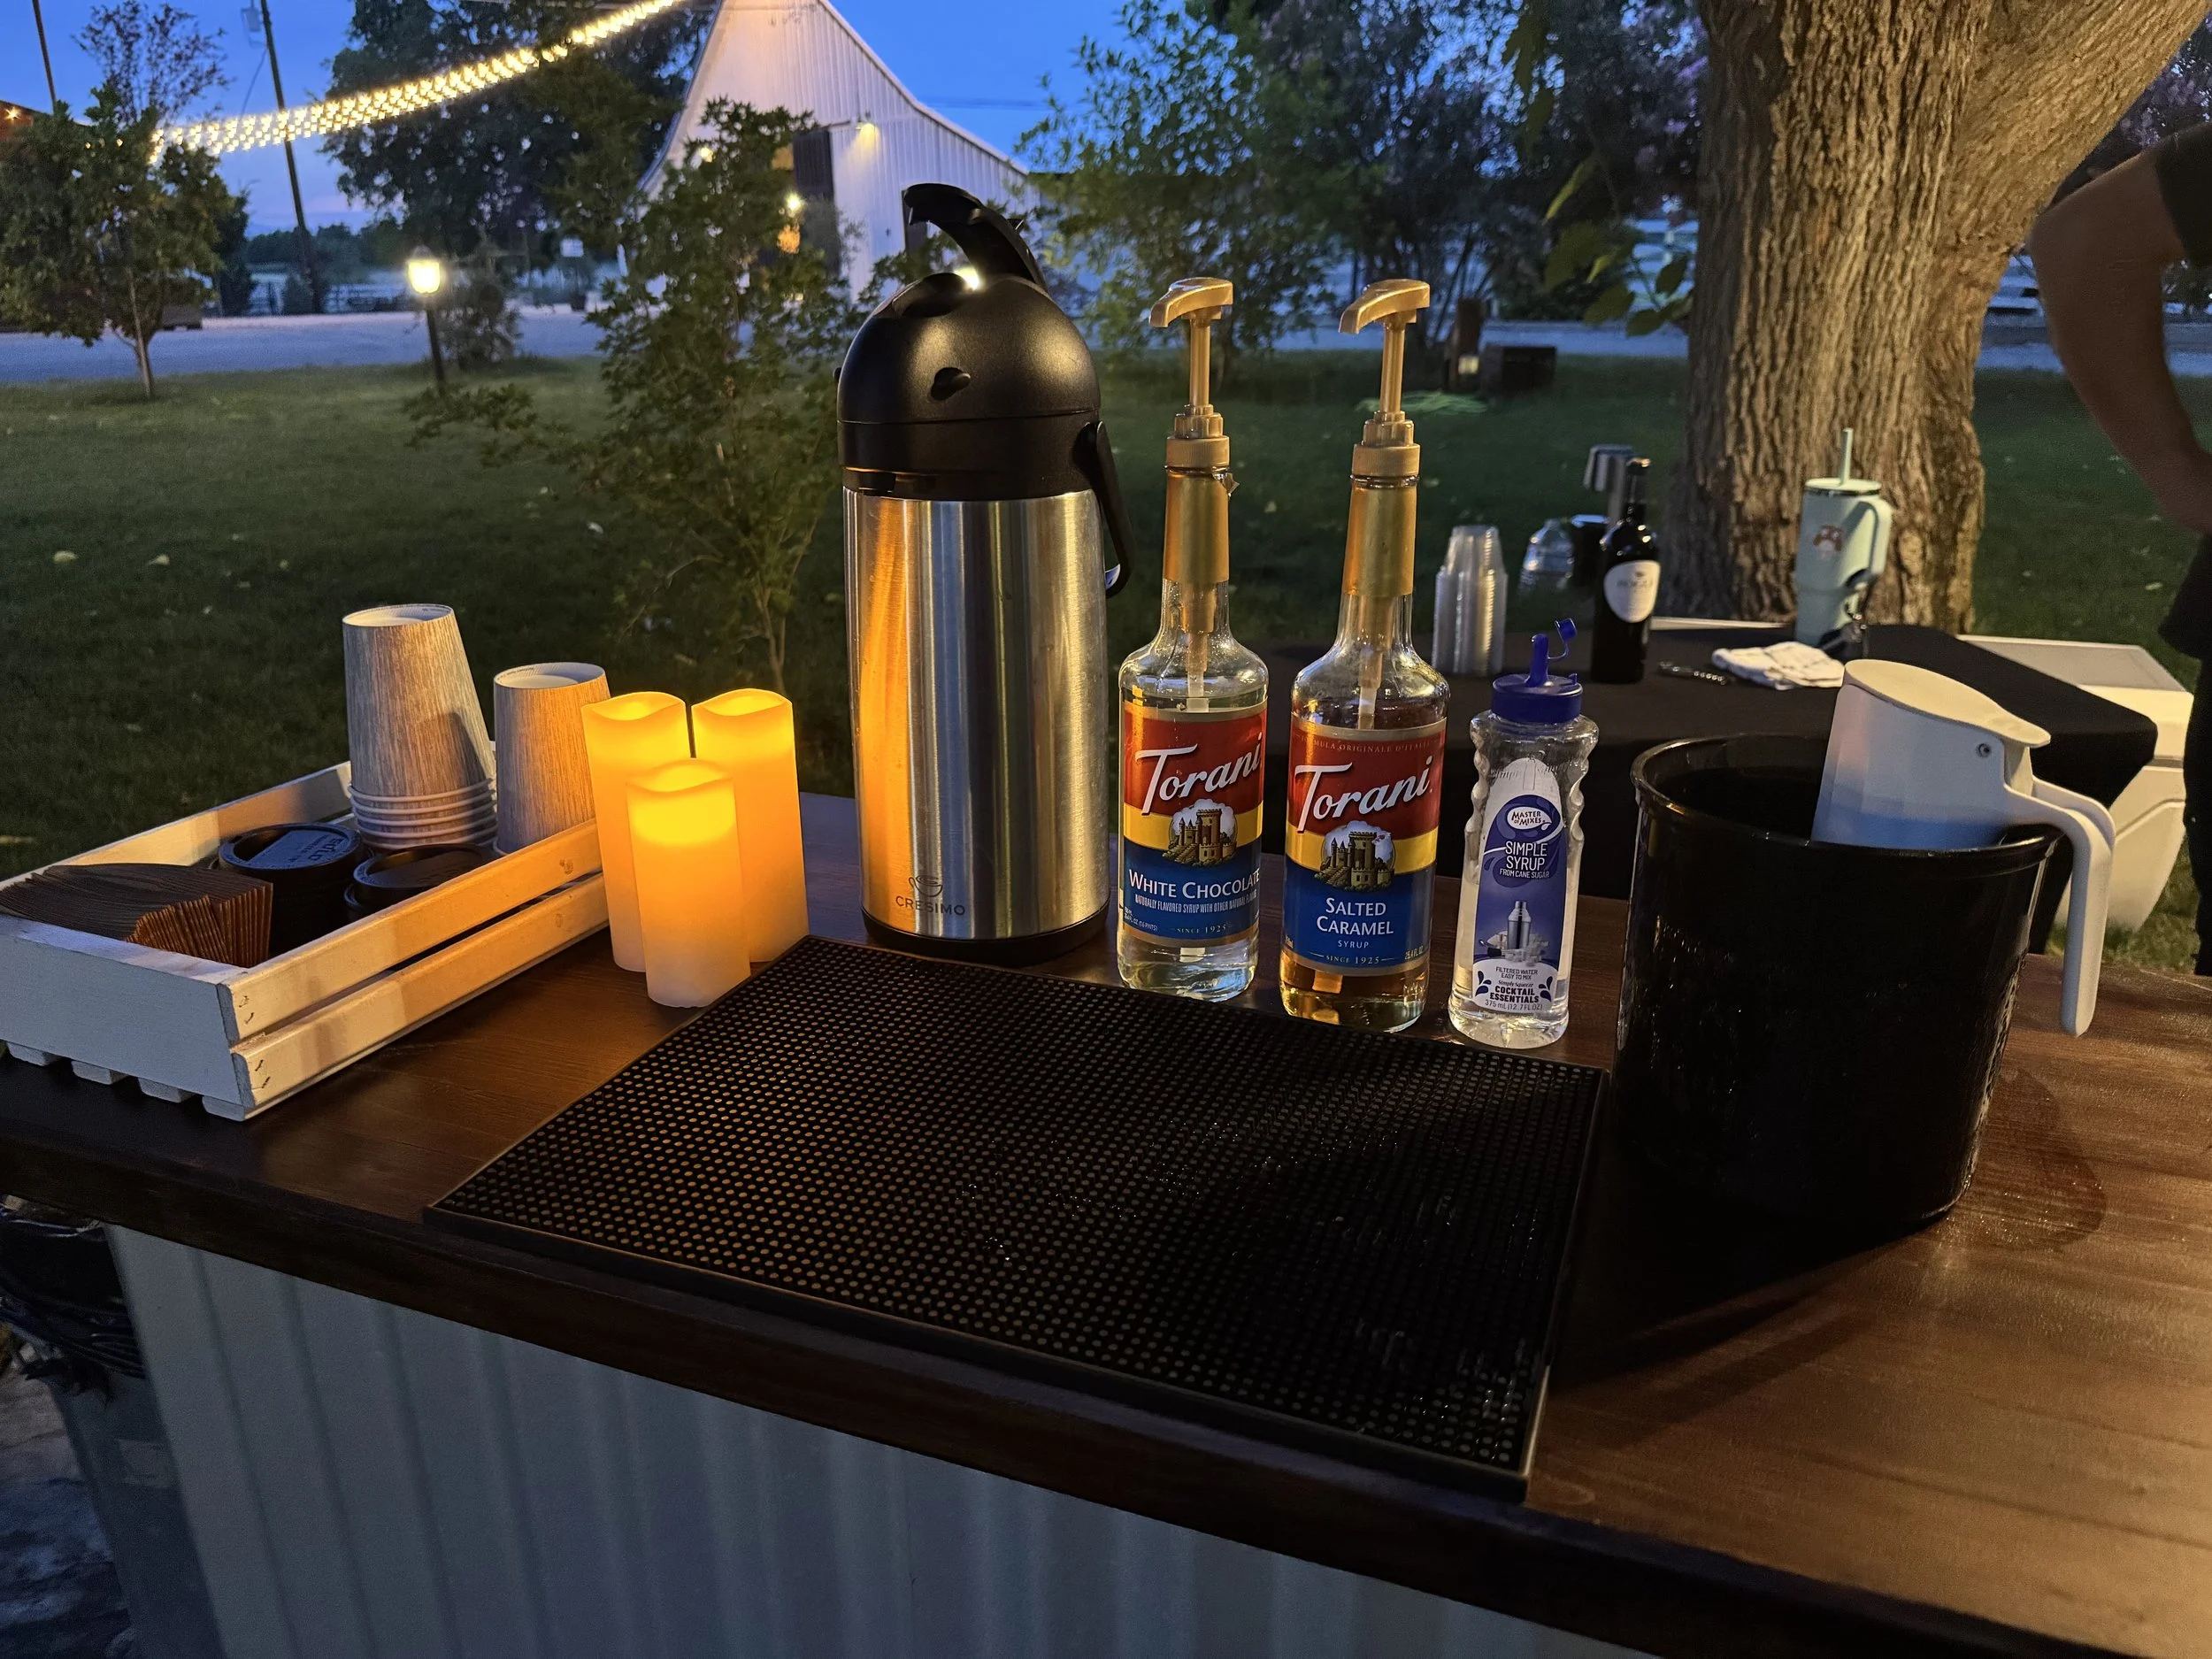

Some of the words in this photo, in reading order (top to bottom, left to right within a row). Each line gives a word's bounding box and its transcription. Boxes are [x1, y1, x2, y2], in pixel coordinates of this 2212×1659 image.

[1301, 736, 1336, 750] FOMULA
[1338, 743, 1392, 754] ORIGINALE
[1135, 731, 1263, 816] Torani
[1294, 755, 1433, 833] Torani
[1511, 810, 1541, 821] MASTER
[1519, 817, 1541, 826] MIXES
[1505, 841, 1548, 856] SIMPLE
[1506, 856, 1545, 871] SYRUP
[1499, 868, 1515, 878] FROM
[1128, 868, 1177, 898] WHITE
[1182, 867, 1260, 899] CHOCOLATE
[895, 895, 965, 916] CRESIMO
[1157, 901, 1182, 912] FLAVORED
[1182, 903, 1200, 914] SYRUP
[1200, 903, 1213, 913] WITH
[1213, 901, 1229, 912] OTHER
[1325, 897, 1386, 917] SALTED
[1205, 924, 1227, 933] 1925
[1317, 915, 1394, 936] CARAMEL
[1337, 940, 1370, 949] SYRUP
[1326, 955, 1351, 964] SINCE
[1494, 985, 1535, 995] COCKTAIL
[1489, 992, 1540, 1003] ESSENTIALS
